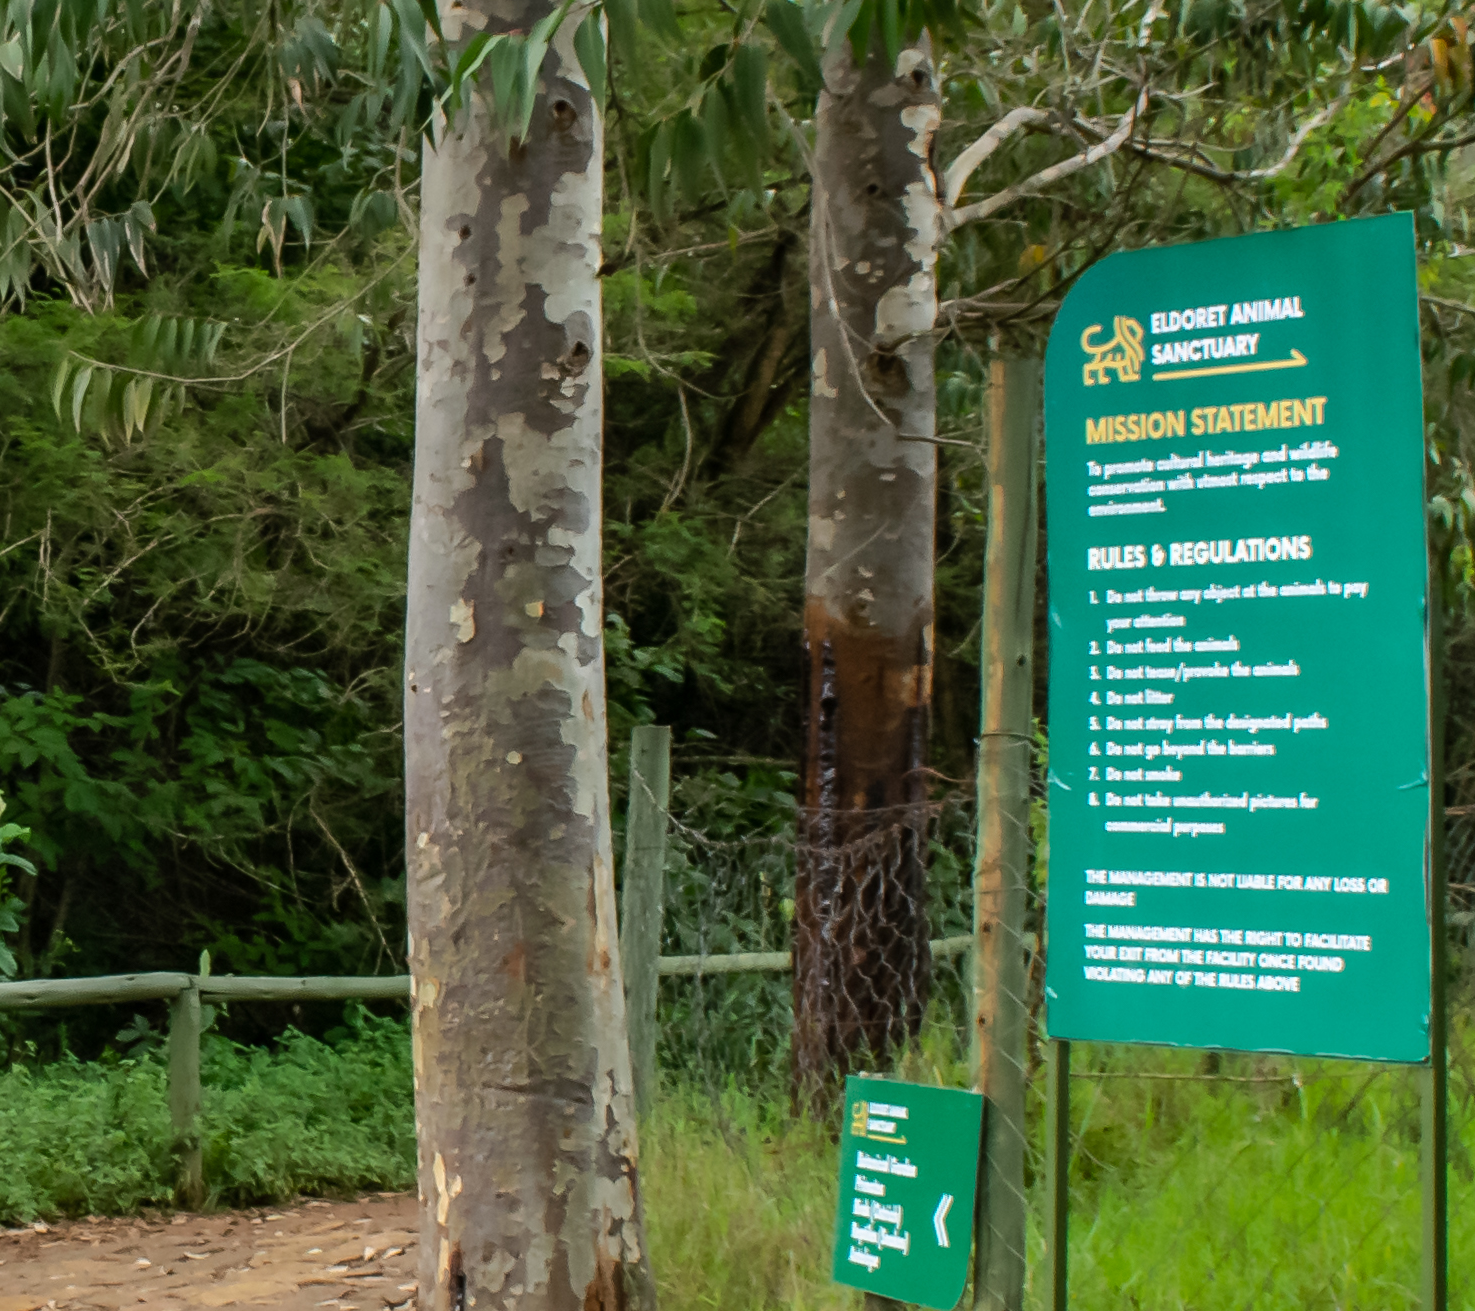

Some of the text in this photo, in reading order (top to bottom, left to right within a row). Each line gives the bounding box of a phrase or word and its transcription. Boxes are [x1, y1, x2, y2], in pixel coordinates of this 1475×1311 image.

[1151, 296, 1304, 332] ELDORET ANIMAL
[1151, 333, 1258, 365] SANCTUARY
[1086, 397, 1327, 444] MISSION STATEMENT
[1089, 536, 1313, 570] RULES & REGULATIONS
[1086, 870, 1389, 893] THE MANAGEMENT IS NOT LIABLE FOR ANY LOSS OR
[1085, 924, 1371, 951] THE MANAGEMENT HAS THE RIGHT TO FACILITATE
[1085, 945, 1345, 972] YOUR EXIT FROM THE FACILITY ONCE FOUND
[1084, 967, 1300, 992] VIOLATING ANY OF THE RULES ABOVE
